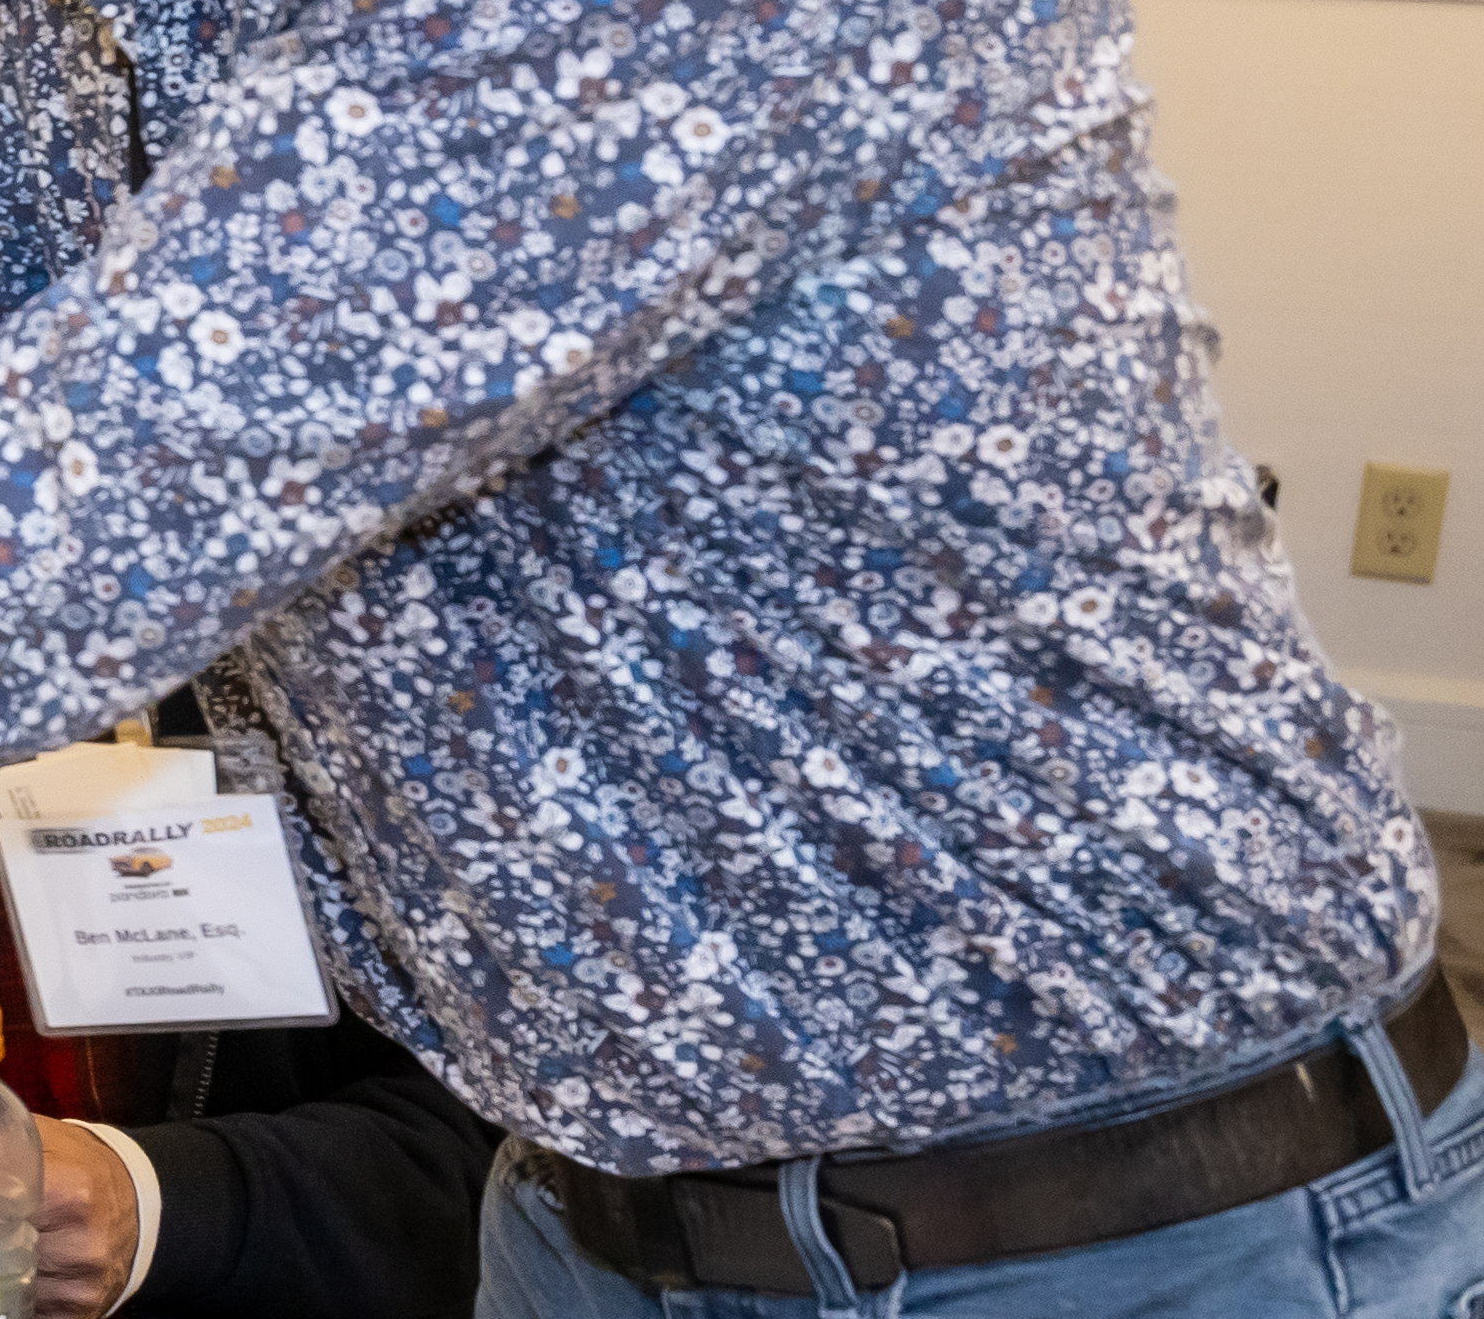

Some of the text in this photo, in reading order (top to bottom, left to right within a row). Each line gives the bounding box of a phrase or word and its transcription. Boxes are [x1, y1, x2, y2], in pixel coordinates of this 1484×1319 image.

[43, 812, 254, 851] ROADRALLY 2024
[74, 921, 247, 947] Ben McLane, Esq.
